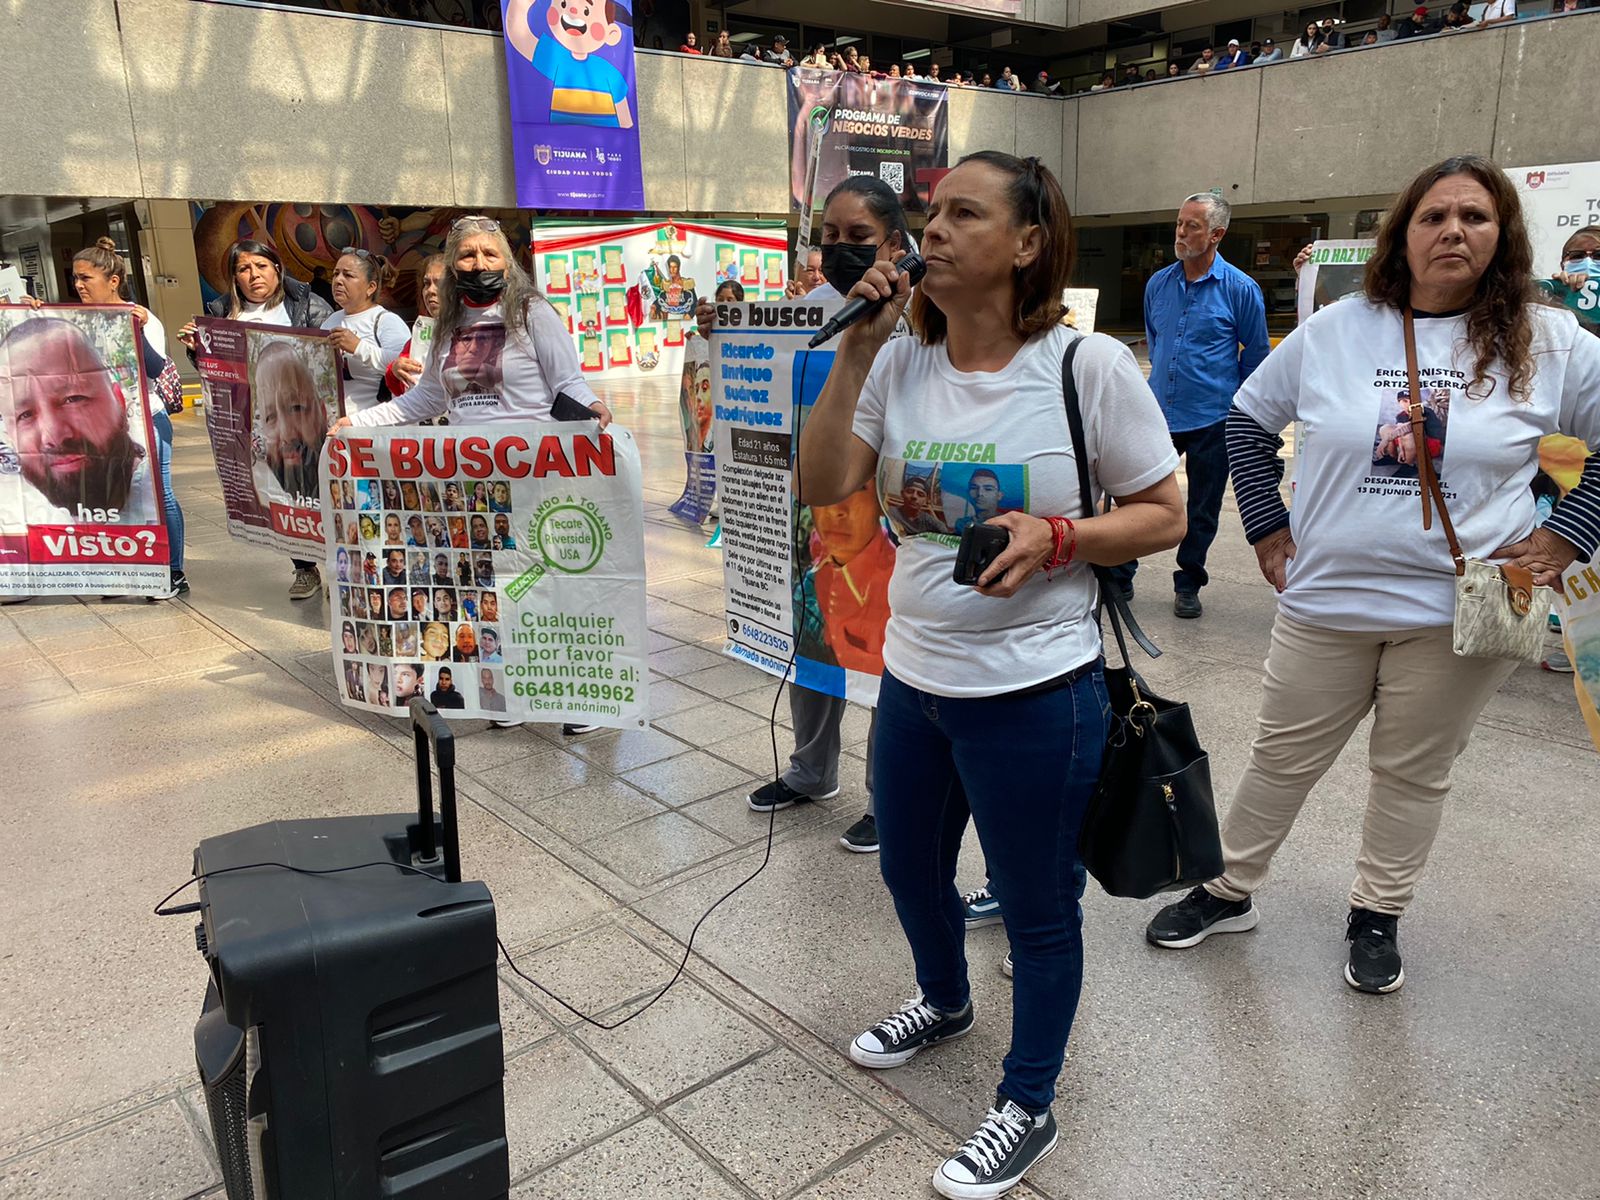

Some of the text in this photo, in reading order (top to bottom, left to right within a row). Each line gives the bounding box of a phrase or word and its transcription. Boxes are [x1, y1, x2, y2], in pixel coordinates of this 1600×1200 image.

[834, 109, 901, 124] PROGRAMA DE
[833, 121, 933, 140] NEGOCIOS VERDES
[553, 150, 587, 159] TIJUANA
[1557, 214, 1581, 227] DE
[1331, 247, 1356, 262] HAZ
[717, 304, 824, 327] Se busca
[721, 343, 775, 360] Ricardo
[721, 364, 773, 383] Enrique
[1373, 380, 1409, 389] ORTIZ
[724, 385, 769, 403] Suárez
[738, 437, 780, 452] Edad 21 años
[902, 440, 996, 463] SE BUSCA
[328, 434, 617, 478] SE BUSCAN
[733, 450, 788, 467] Estatura 1.65 mts
[721, 475, 740, 485] morena
[741, 478, 761, 490] tatuajes
[762, 481, 777, 492] figura
[778, 484, 785, 493] de
[1364, 477, 1421, 487] DESAPARECI
[296, 491, 320, 509] has
[566, 495, 574, 503] A
[725, 485, 729, 493] la
[730, 488, 740, 496] cara
[741, 489, 748, 497] de
[749, 491, 755, 499] un
[778, 496, 783, 504] el
[1382, 488, 1412, 497] JUNIO
[77, 503, 121, 523] has
[721, 496, 743, 507] abdomen
[744, 501, 748, 510] y
[782, 507, 788, 516] la
[528, 496, 560, 550] BUSCANDO
[551, 518, 582, 529] Tecate
[580, 497, 613, 541] TOLANO
[758, 514, 764, 522] en
[765, 514, 770, 523] la
[736, 519, 758, 531] izquierdo
[782, 529, 787, 538] la
[42, 527, 156, 557] visto?
[545, 533, 591, 545] Riverside
[757, 535, 775, 546] playera
[776, 540, 790, 551] negra
[560, 549, 580, 560] USA
[756, 546, 777, 557] pantalón
[737, 564, 743, 572] de
[743, 566, 754, 576] julio
[755, 569, 763, 578] del
[747, 556, 755, 565] por
[773, 564, 782, 574] vez
[741, 575, 768, 591] Tijuana BC
[747, 593, 775, 607] información
[521, 612, 615, 631] Cualquier
[512, 628, 625, 647] información
[743, 624, 788, 652] 6648223529
[527, 645, 614, 664] por favor
[620, 666, 640, 682] al:
[513, 681, 634, 702] 6648149962
[529, 698, 621, 717] (Será anónimo)
